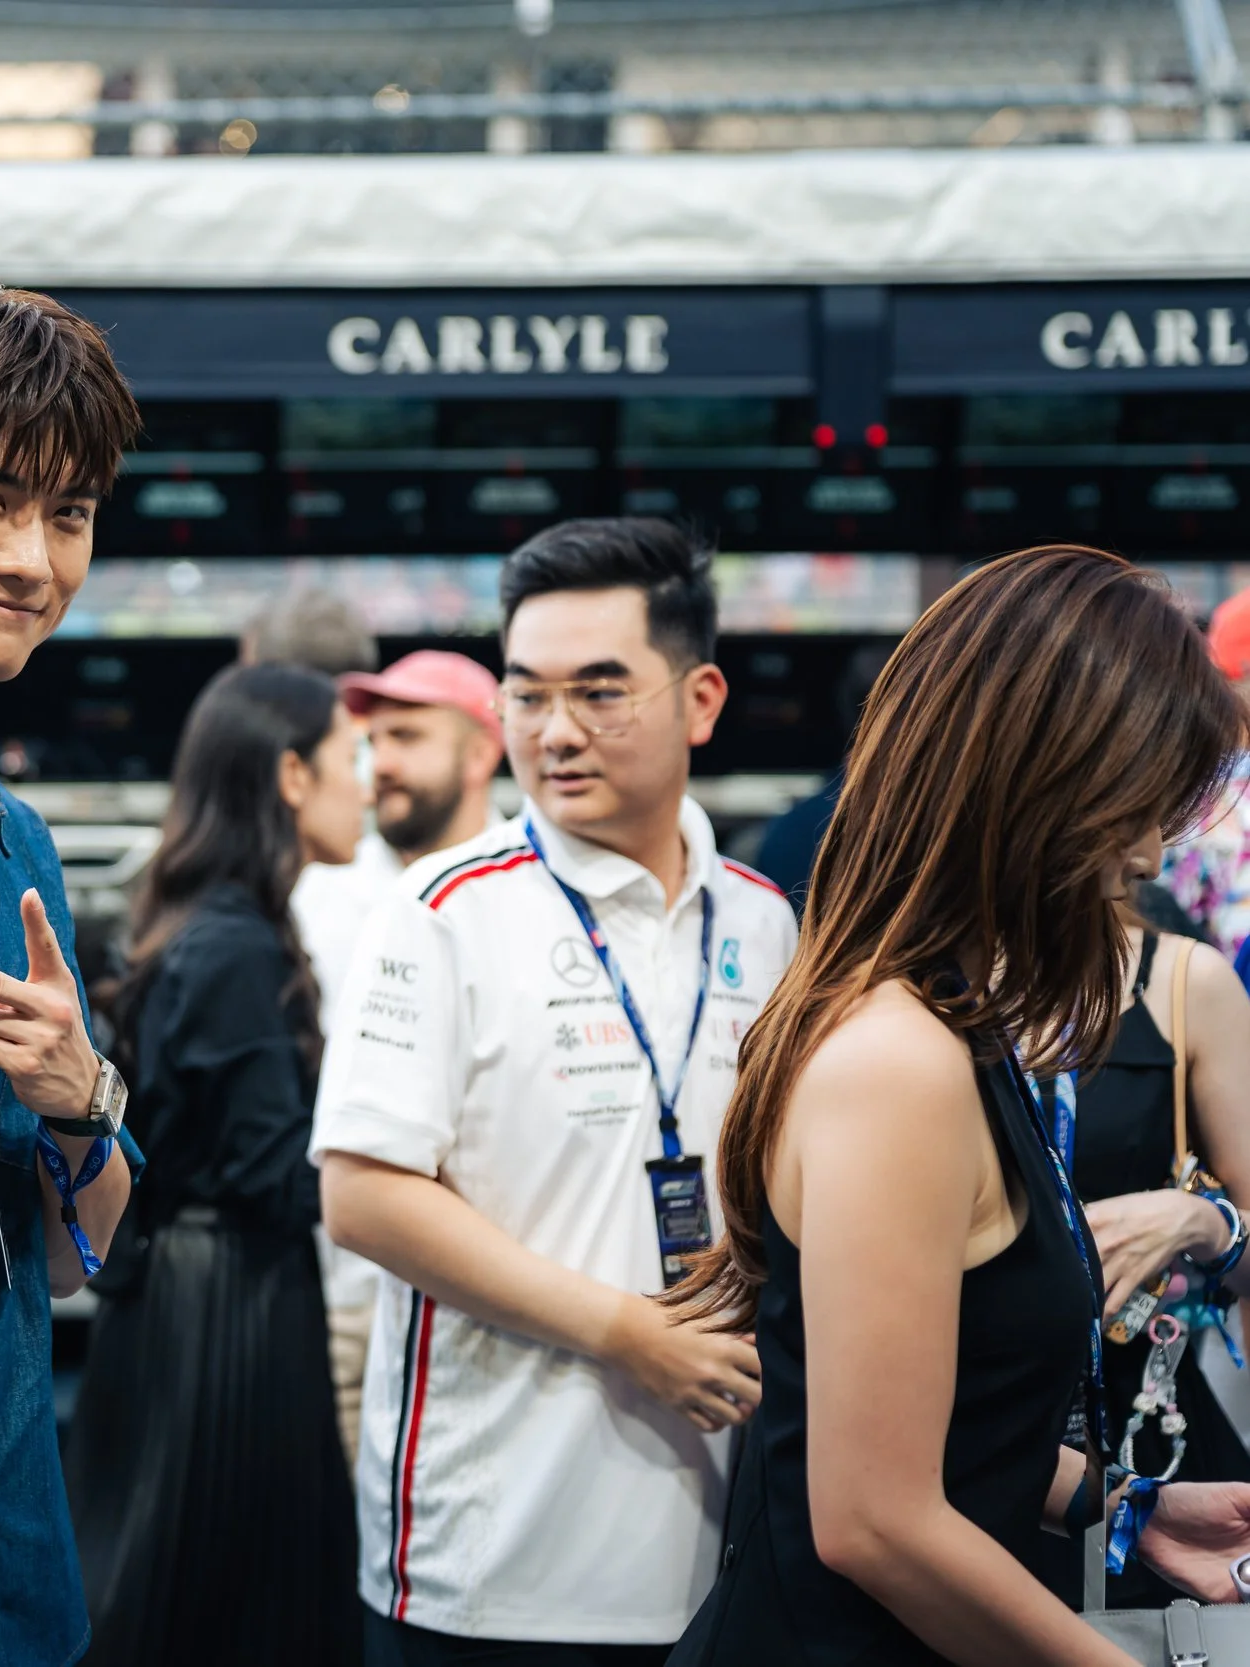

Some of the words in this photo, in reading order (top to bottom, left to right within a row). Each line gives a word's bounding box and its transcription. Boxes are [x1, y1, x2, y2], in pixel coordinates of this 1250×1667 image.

[327, 315, 669, 375] CARLYLE
[1040, 308, 1250, 370] CARL
[584, 1022, 630, 1045] UBS
[1114, 1500, 1128, 1529] SU
